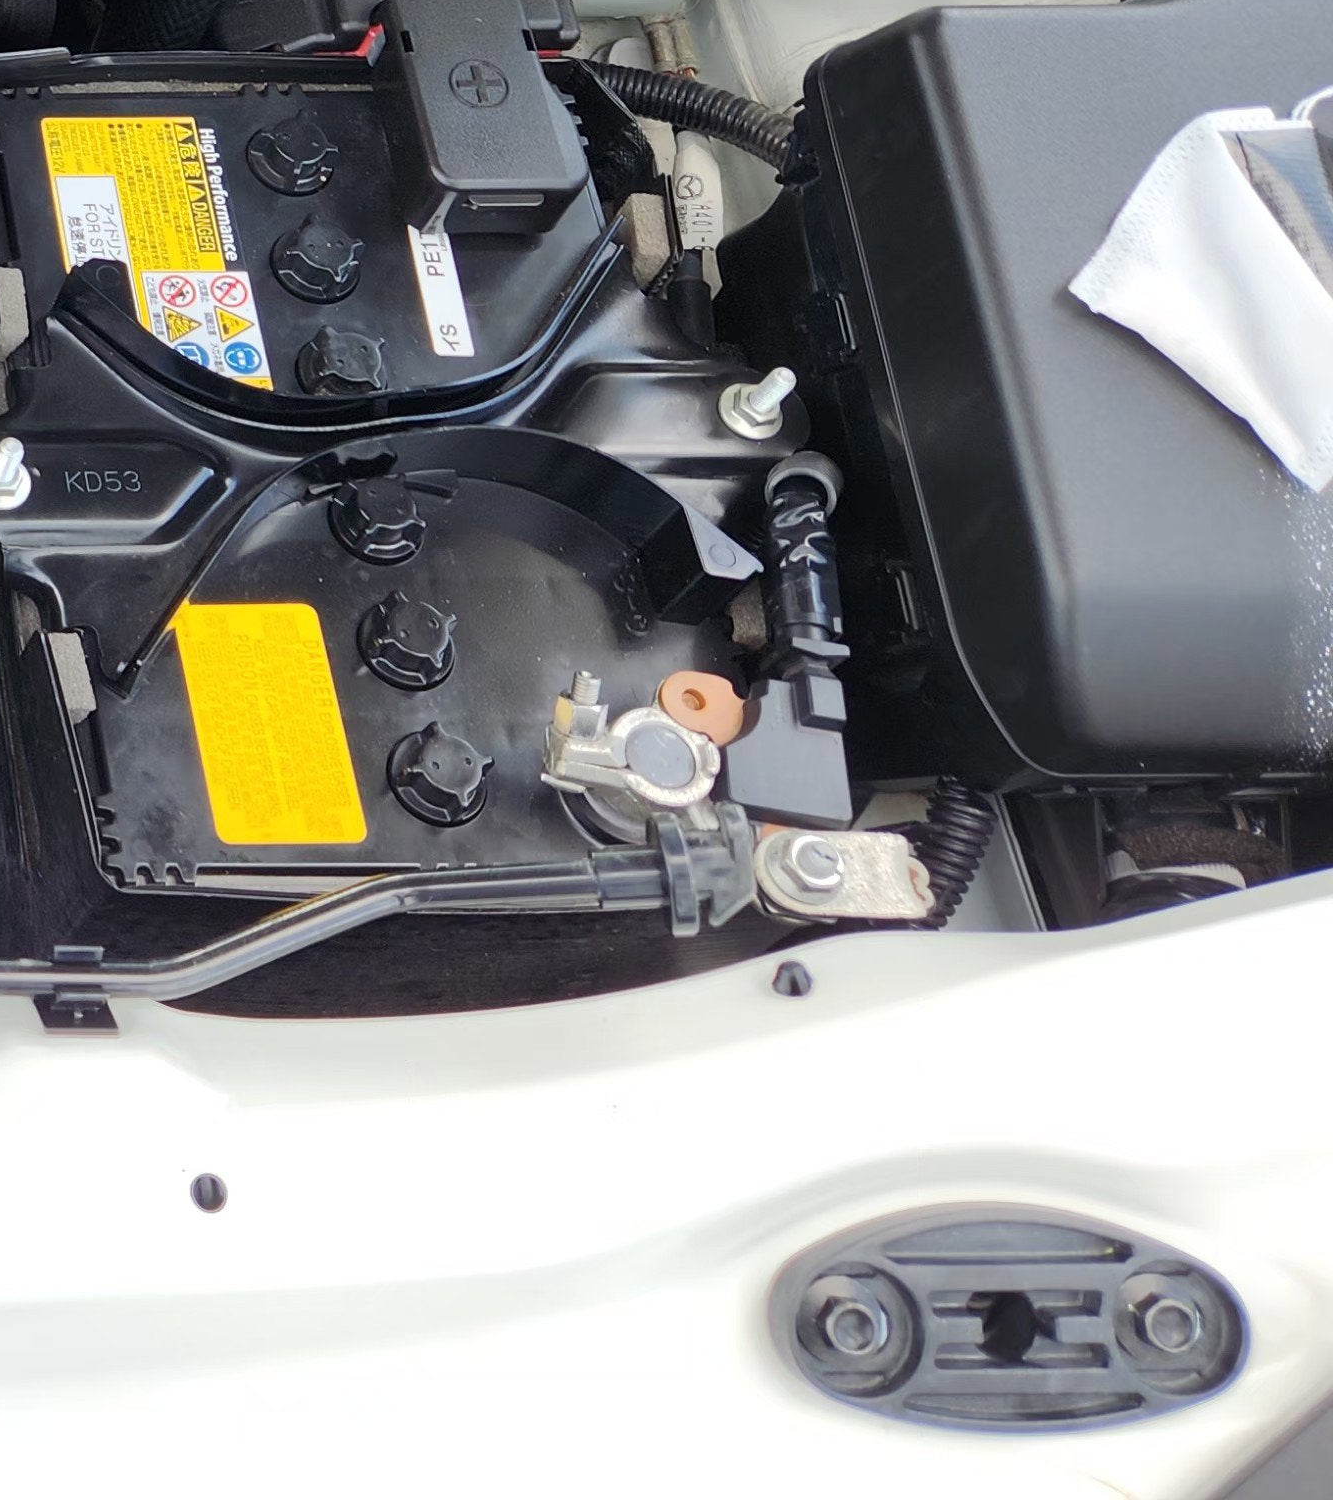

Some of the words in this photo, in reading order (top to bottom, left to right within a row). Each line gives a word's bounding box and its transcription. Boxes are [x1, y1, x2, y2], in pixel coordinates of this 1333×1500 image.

[177, 142, 203, 179] 危険
[199, 127, 220, 163] High
[83, 203, 100, 233] FOR
[191, 201, 217, 252] DANGER
[207, 165, 239, 262] Performance
[64, 470, 141, 493] KD53
[235, 634, 257, 691] POISON
[303, 639, 334, 709] DANGER
